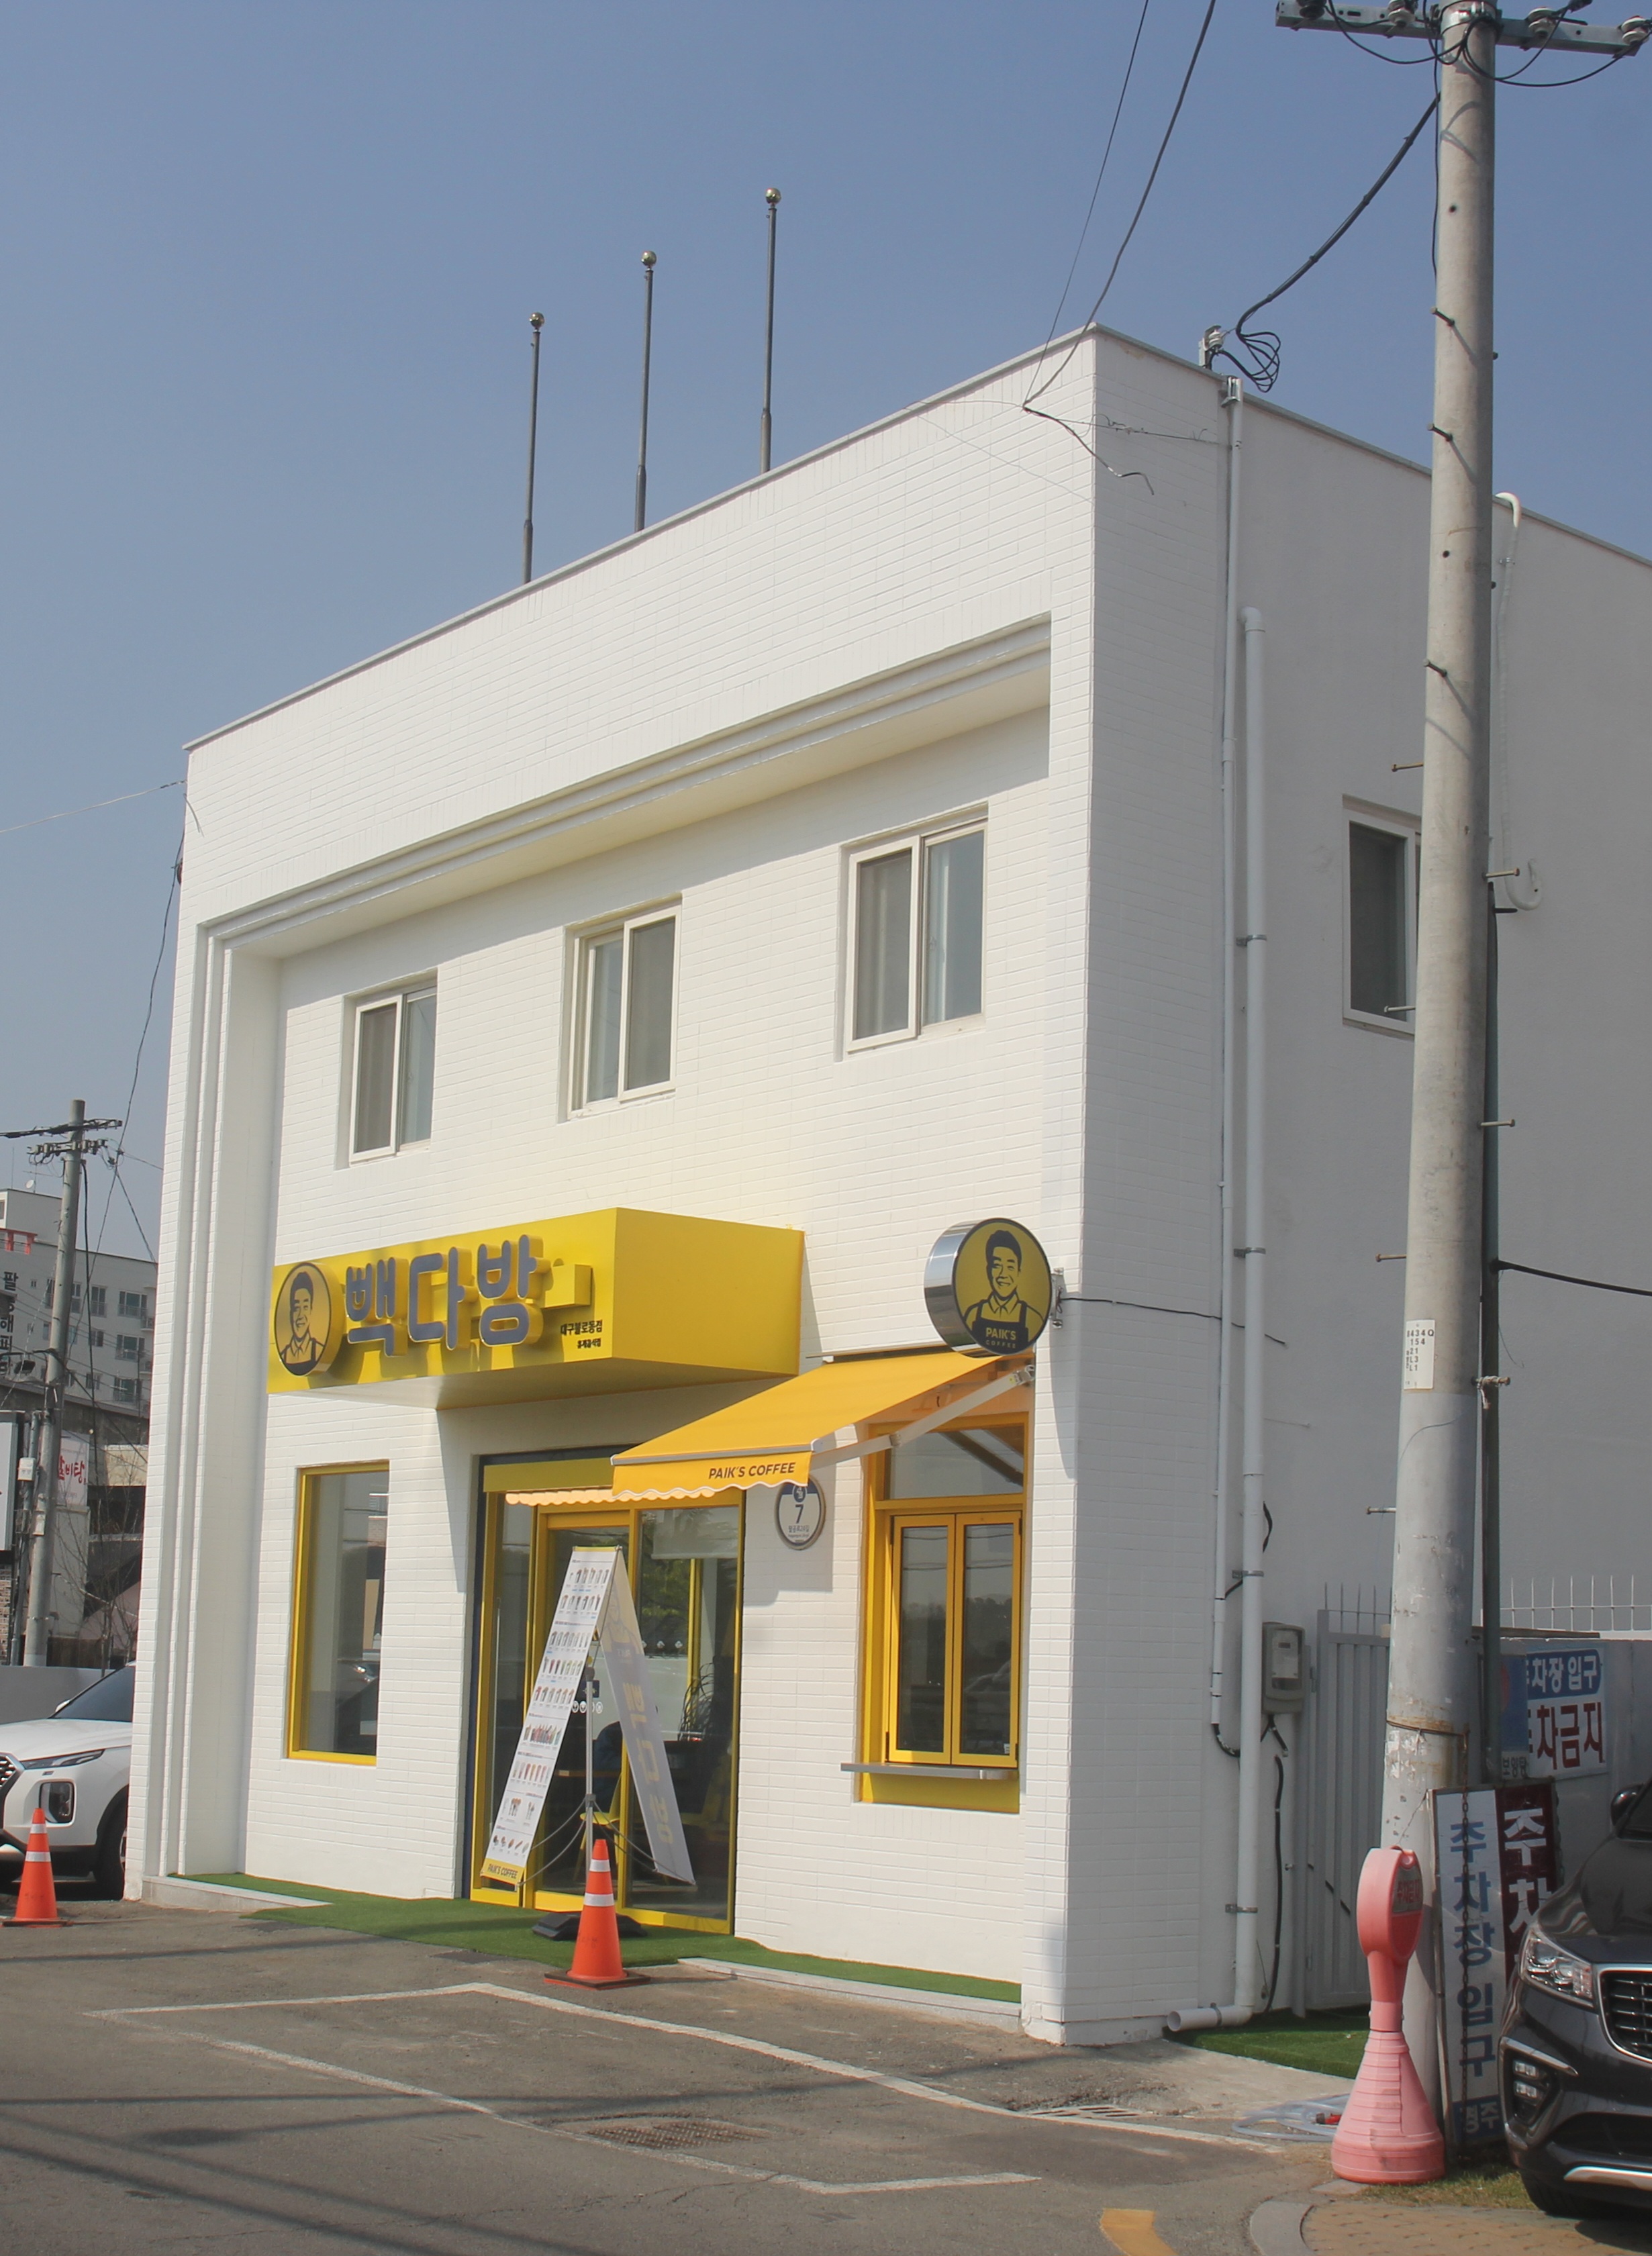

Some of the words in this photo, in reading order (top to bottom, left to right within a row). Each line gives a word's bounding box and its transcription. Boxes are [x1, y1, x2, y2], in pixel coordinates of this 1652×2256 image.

[345, 1234, 539, 1357] 빽다방
[986, 1327, 1016, 1340] PAIK'S
[1410, 1338, 1426, 1346] 154
[986, 1340, 1016, 1348] COFFEE
[708, 1465, 745, 1479] PAIK'S
[748, 1461, 797, 1477] COFFEE
[795, 1504, 804, 1524] 7
[1526, 1657, 1564, 1693] 차장
[1528, 1702, 1603, 1770] 차금지
[501, 1867, 518, 1879] COFFEE
[1504, 1808, 1553, 1962] 주차
